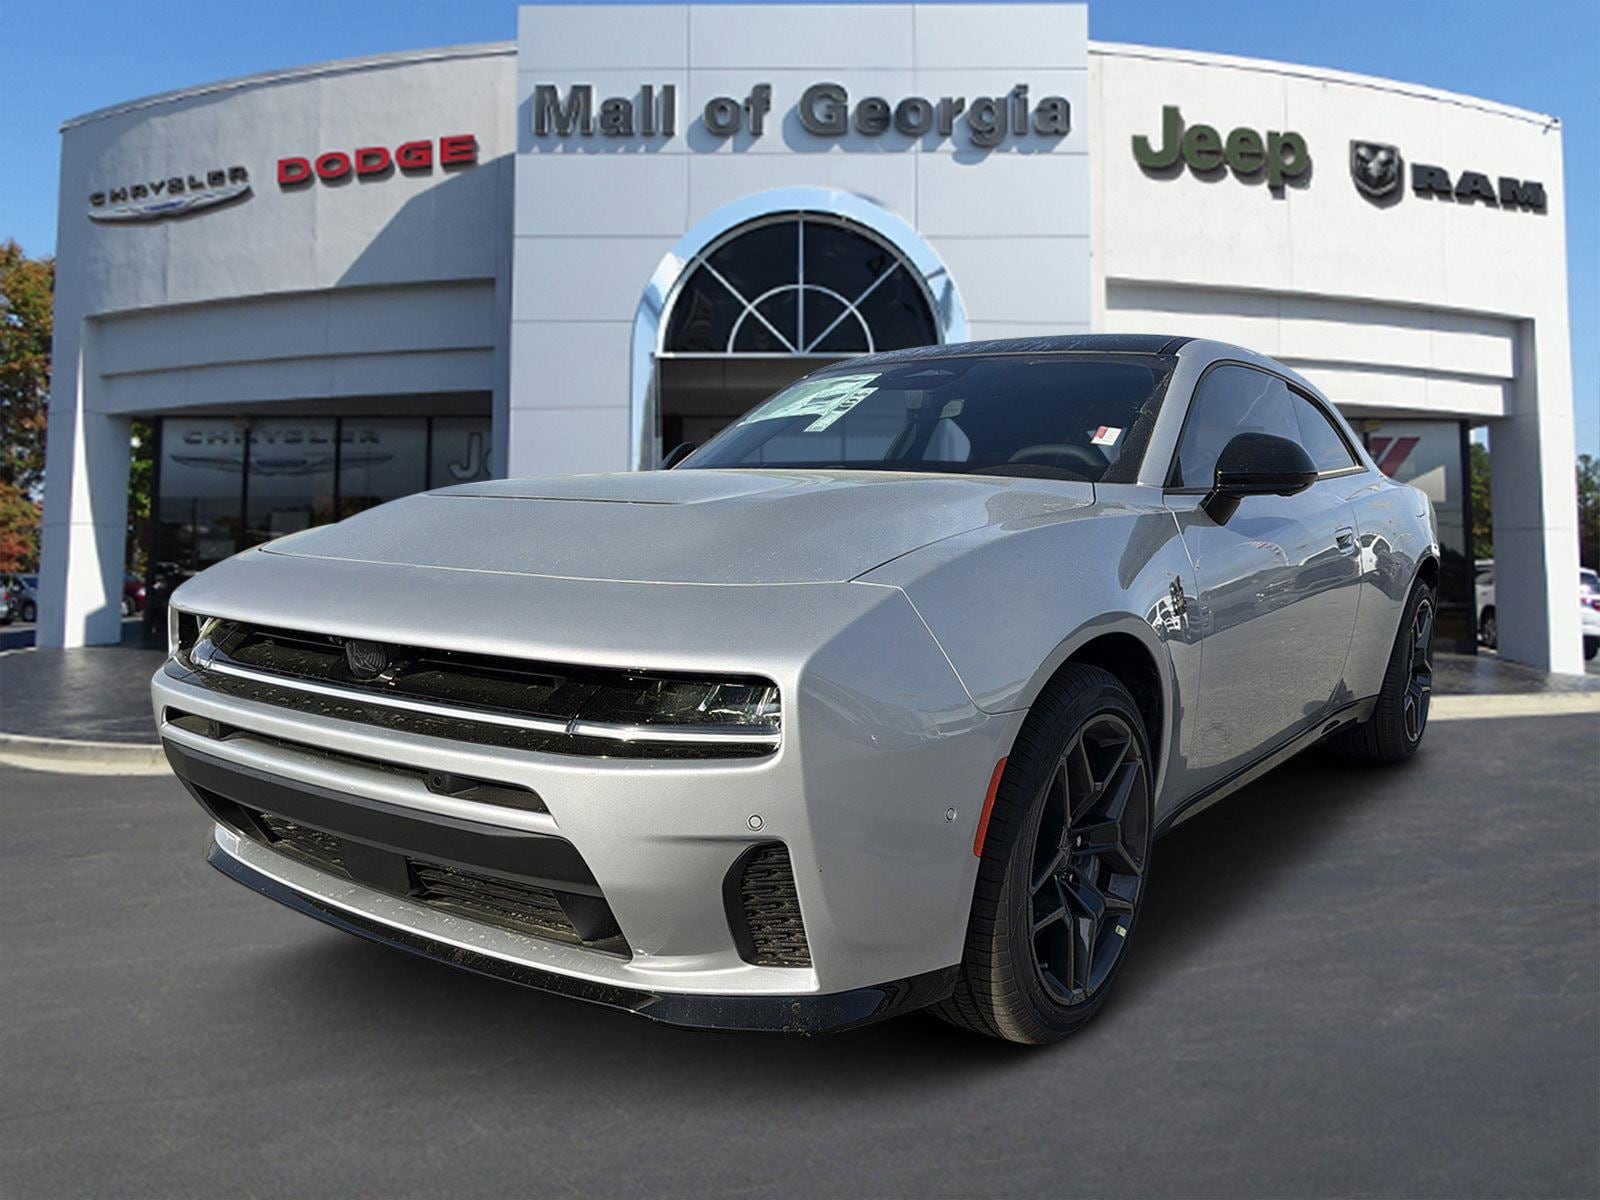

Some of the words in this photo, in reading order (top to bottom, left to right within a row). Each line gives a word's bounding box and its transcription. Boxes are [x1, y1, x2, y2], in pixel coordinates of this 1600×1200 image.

[532, 83, 677, 139] Mall
[704, 84, 773, 137] of
[799, 83, 1072, 148] Georgia
[277, 134, 476, 187] DODGE
[1132, 105, 1310, 191] Jeep
[90, 166, 249, 206] CHRYSLER
[1411, 163, 1547, 212] RAM
